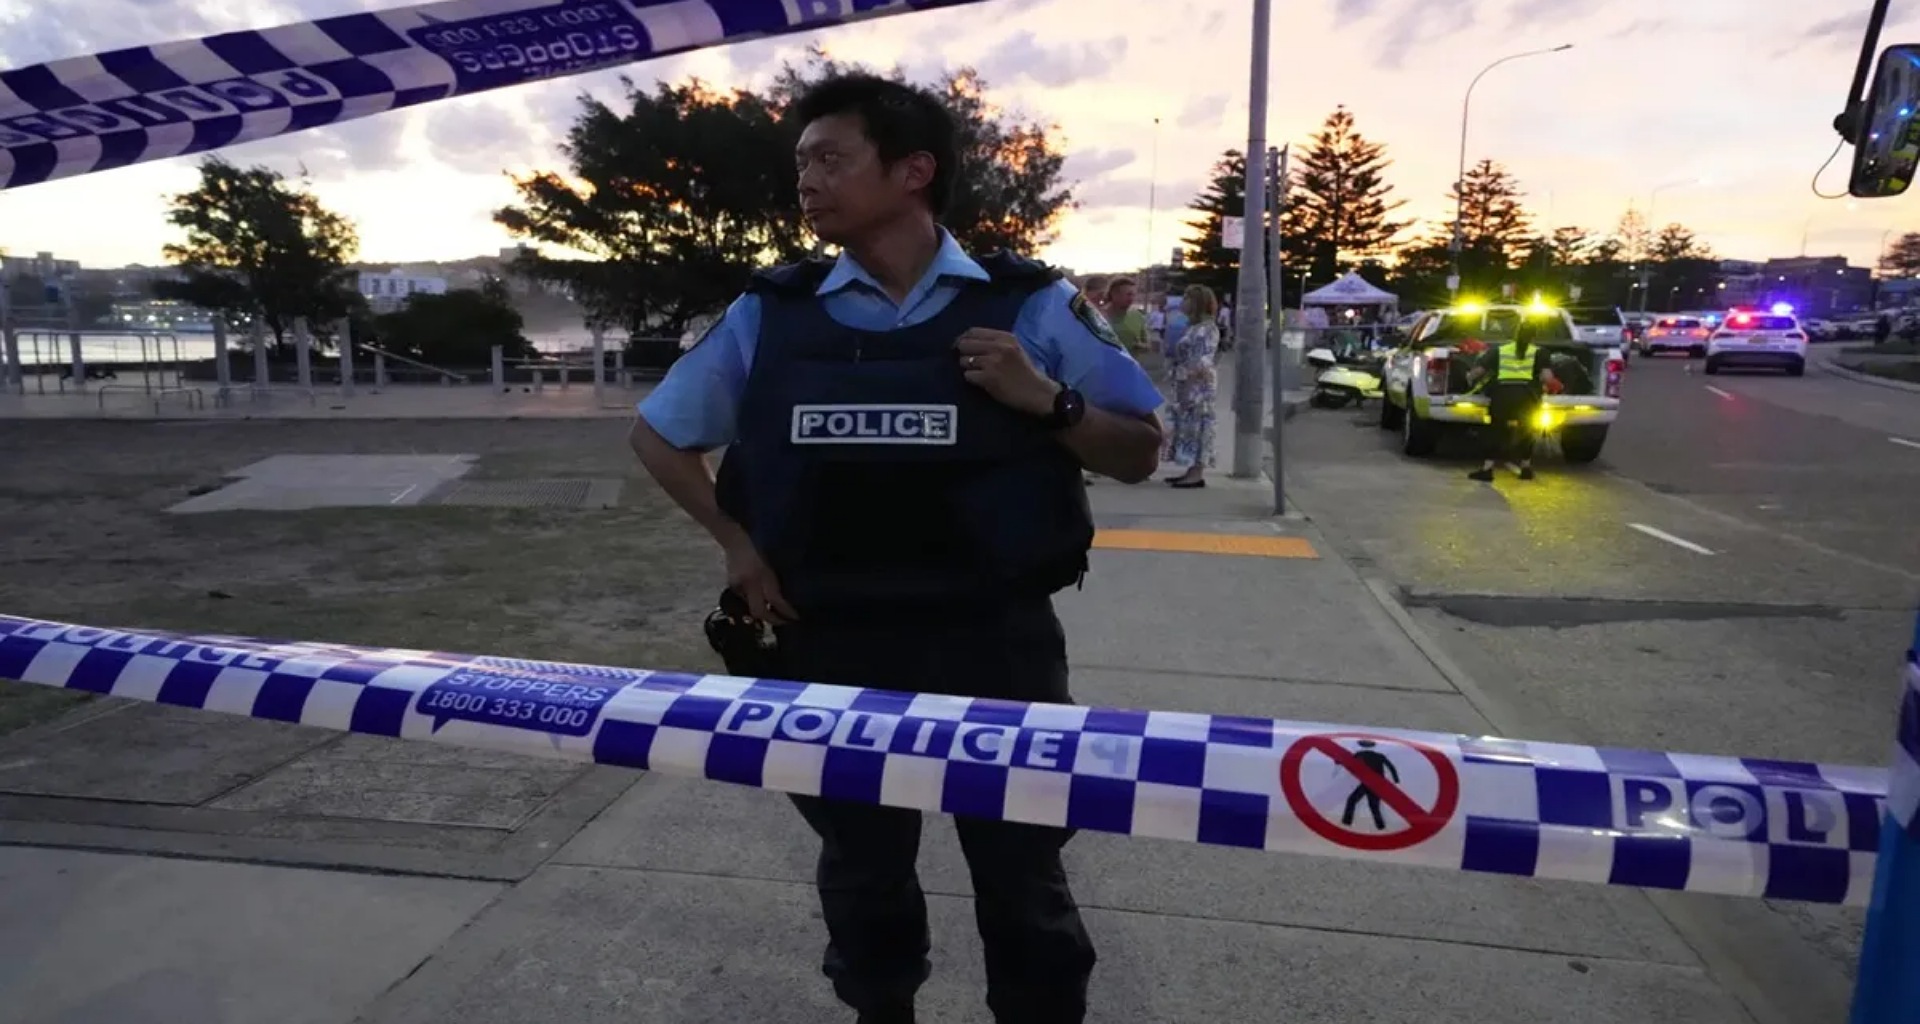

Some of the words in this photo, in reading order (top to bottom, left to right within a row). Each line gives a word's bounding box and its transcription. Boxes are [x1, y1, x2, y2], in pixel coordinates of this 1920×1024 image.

[453, 24, 640, 73] STOPPERS
[13, 70, 329, 137] POLICE
[801, 412, 947, 436] POLICE
[427, 690, 487, 713] 1800
[489, 698, 537, 720] 333
[538, 706, 588, 728] 000
[448, 674, 609, 701] STOPPERS
[727, 701, 1064, 767] POLICE
